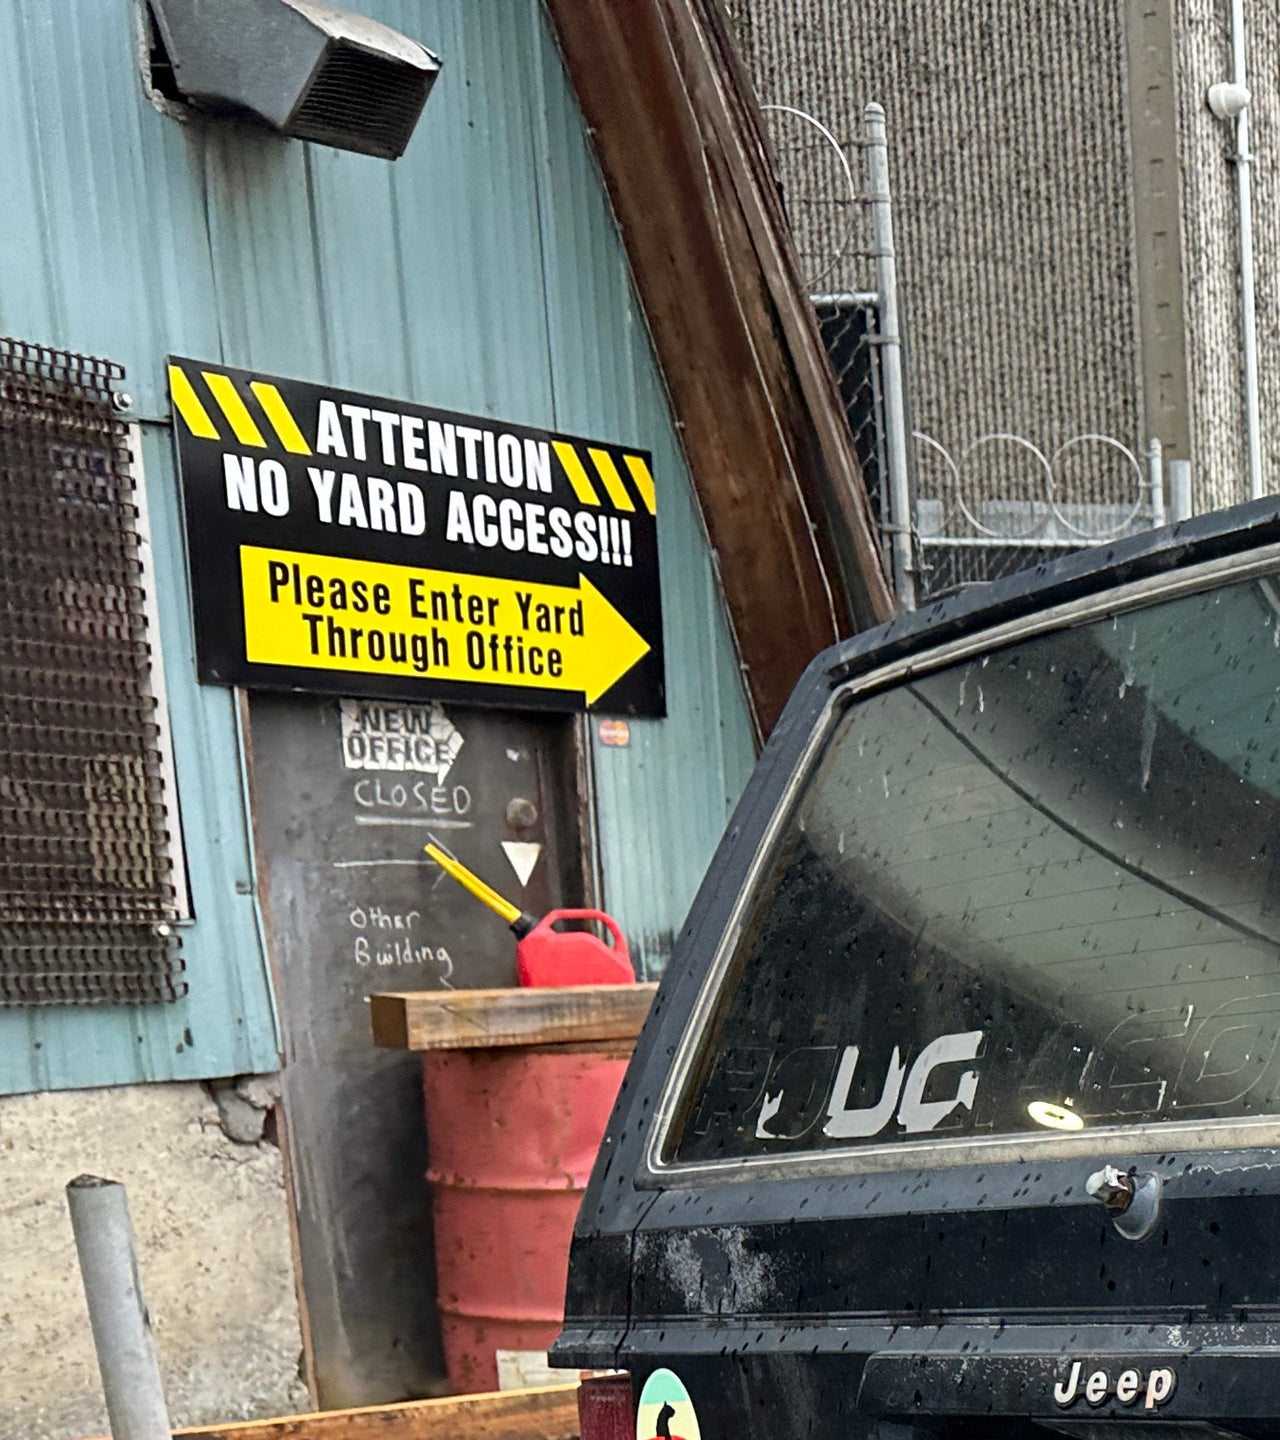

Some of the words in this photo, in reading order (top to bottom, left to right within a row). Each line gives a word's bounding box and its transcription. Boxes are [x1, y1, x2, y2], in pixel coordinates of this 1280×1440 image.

[316, 400, 553, 494] ATTENTION
[222, 453, 290, 517] NO
[309, 469, 426, 537] YARD
[446, 491, 633, 567] ACCESS!!!
[268, 561, 391, 616] Please
[410, 578, 499, 627] Enter
[515, 592, 585, 636] Yard
[302, 614, 450, 673] Through
[467, 630, 564, 678] Office
[360, 704, 432, 734] NEW
[348, 730, 453, 765] OFFICE
[354, 779, 472, 815] CLOSED
[355, 936, 454, 976] Building
[1054, 1361, 1177, 1410] Jeep
